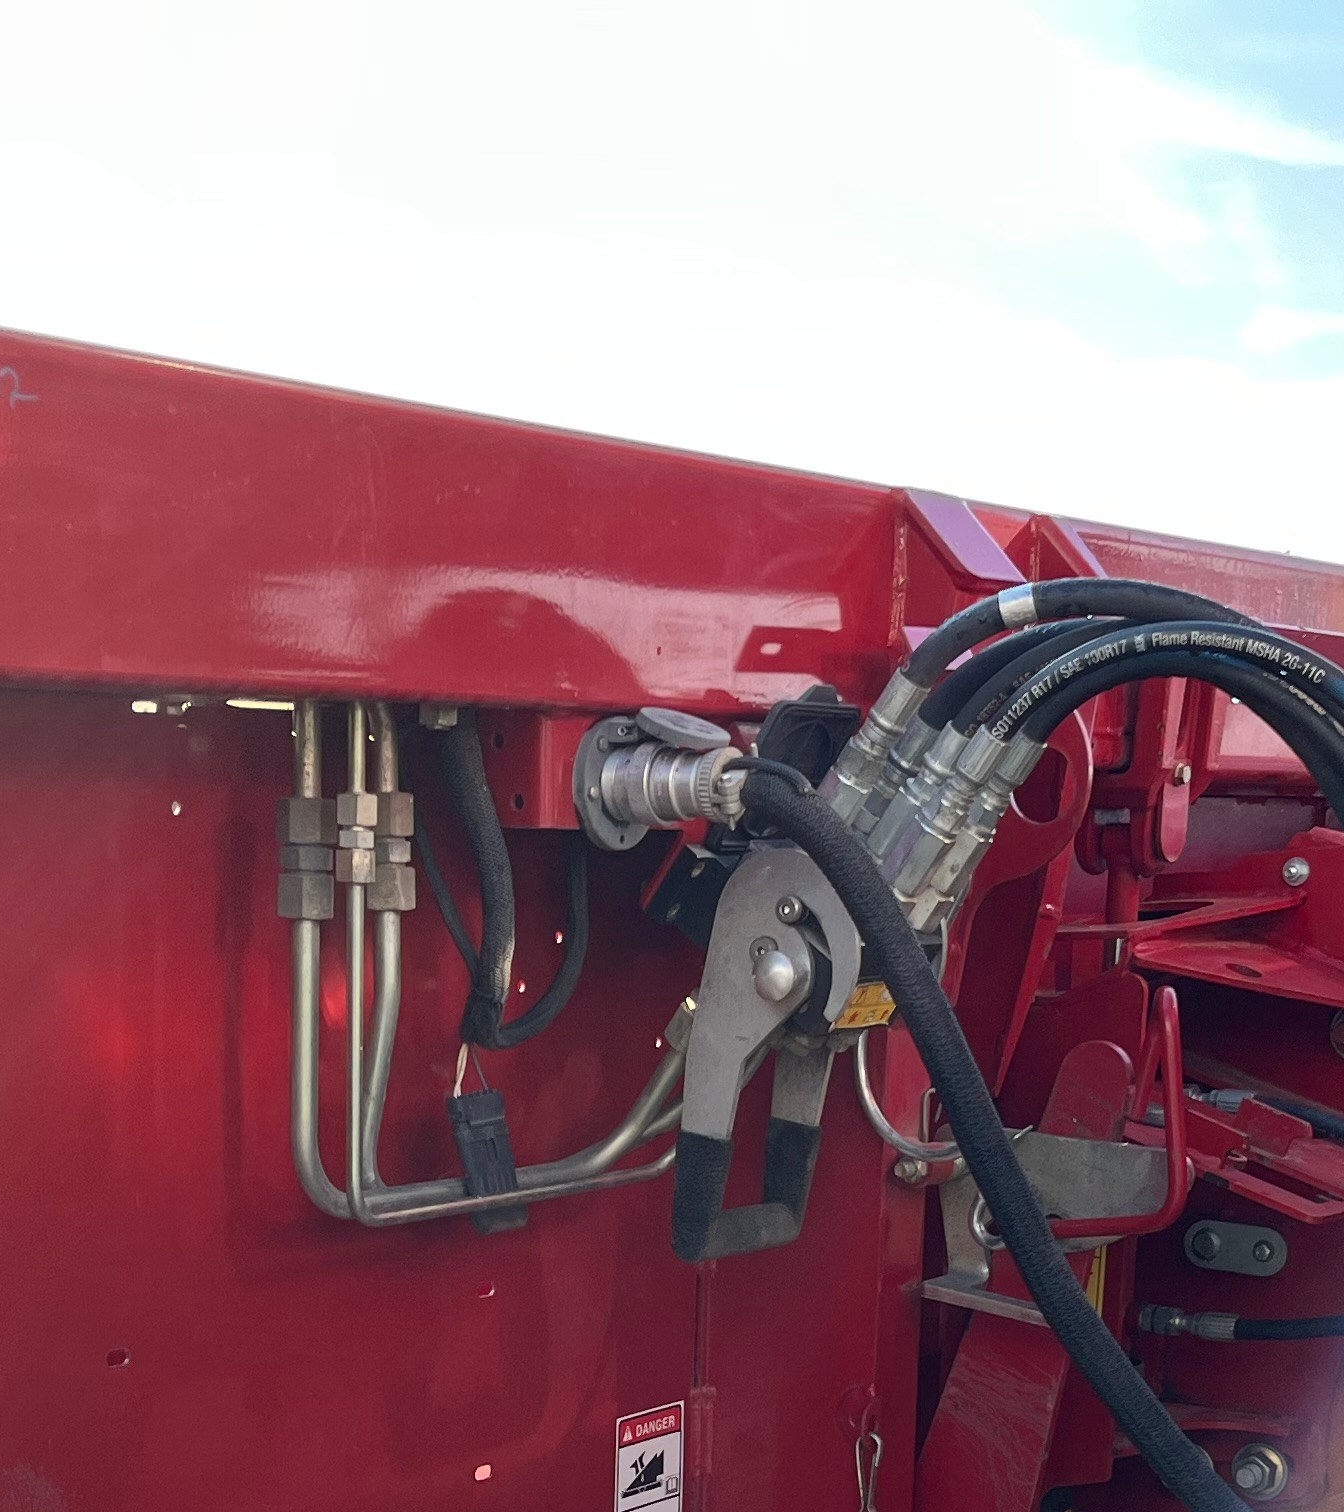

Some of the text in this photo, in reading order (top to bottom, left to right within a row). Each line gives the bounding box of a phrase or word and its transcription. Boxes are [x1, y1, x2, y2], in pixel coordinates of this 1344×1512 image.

[1030, 676, 1052, 700] R17
[1059, 657, 1086, 681] SAE
[1151, 631, 1188, 648] Flame
[1190, 630, 1244, 652] Resistant
[1245, 638, 1281, 664] MSHA
[1282, 651, 1327, 685] 2G-11C
[636, 1415, 675, 1437] DANGER
